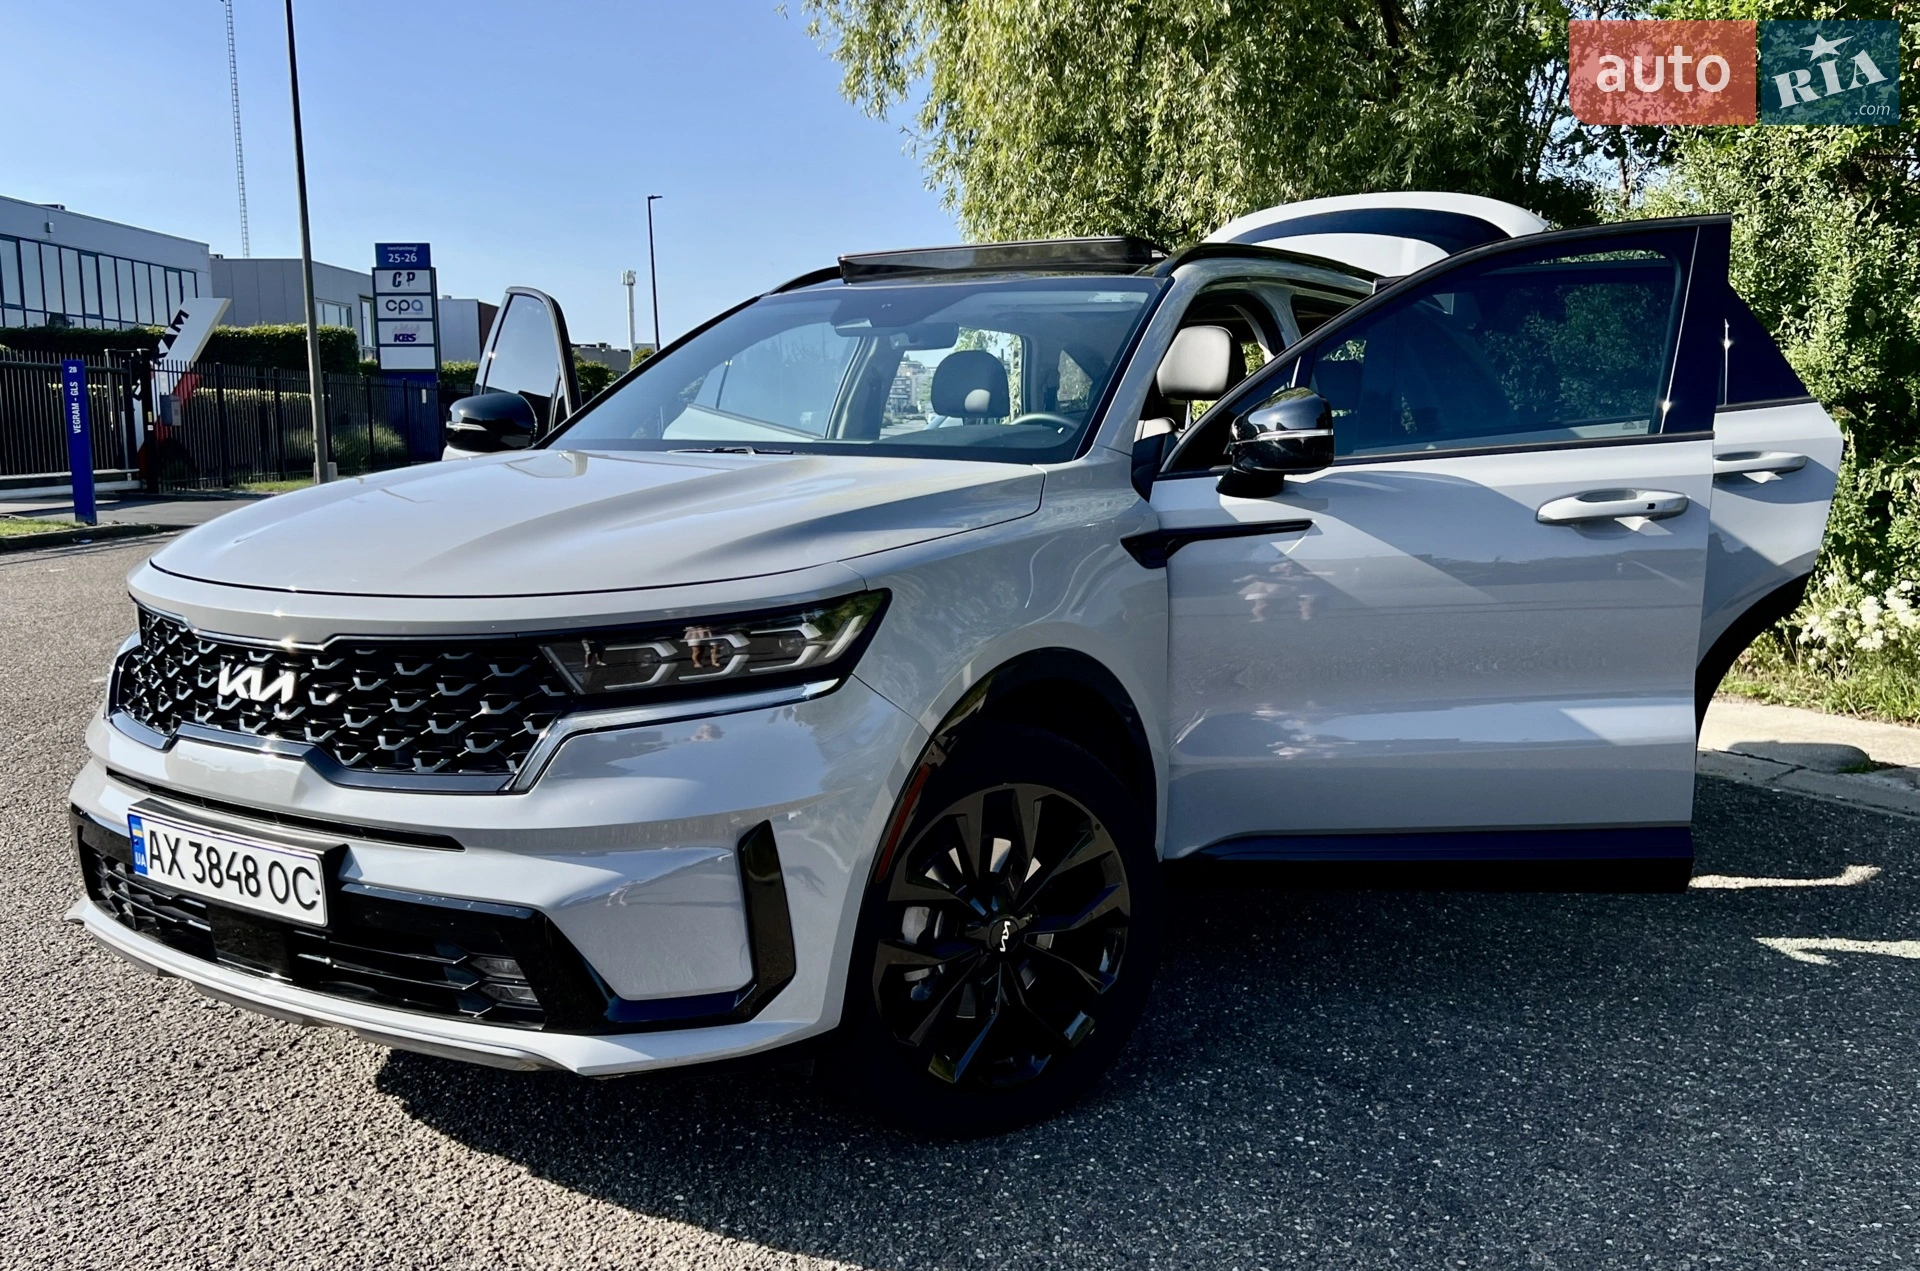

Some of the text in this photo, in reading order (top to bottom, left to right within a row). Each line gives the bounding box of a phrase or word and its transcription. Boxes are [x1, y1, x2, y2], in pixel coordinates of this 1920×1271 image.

[388, 253, 418, 263] 25-26
[385, 299, 424, 315] cpa
[393, 333, 417, 342] KBS
[69, 381, 79, 396] GLS
[71, 402, 82, 434] VEGRAM
[218, 663, 296, 704] KIA
[135, 854, 147, 867] UA
[149, 829, 319, 911] AX 3848 OC
